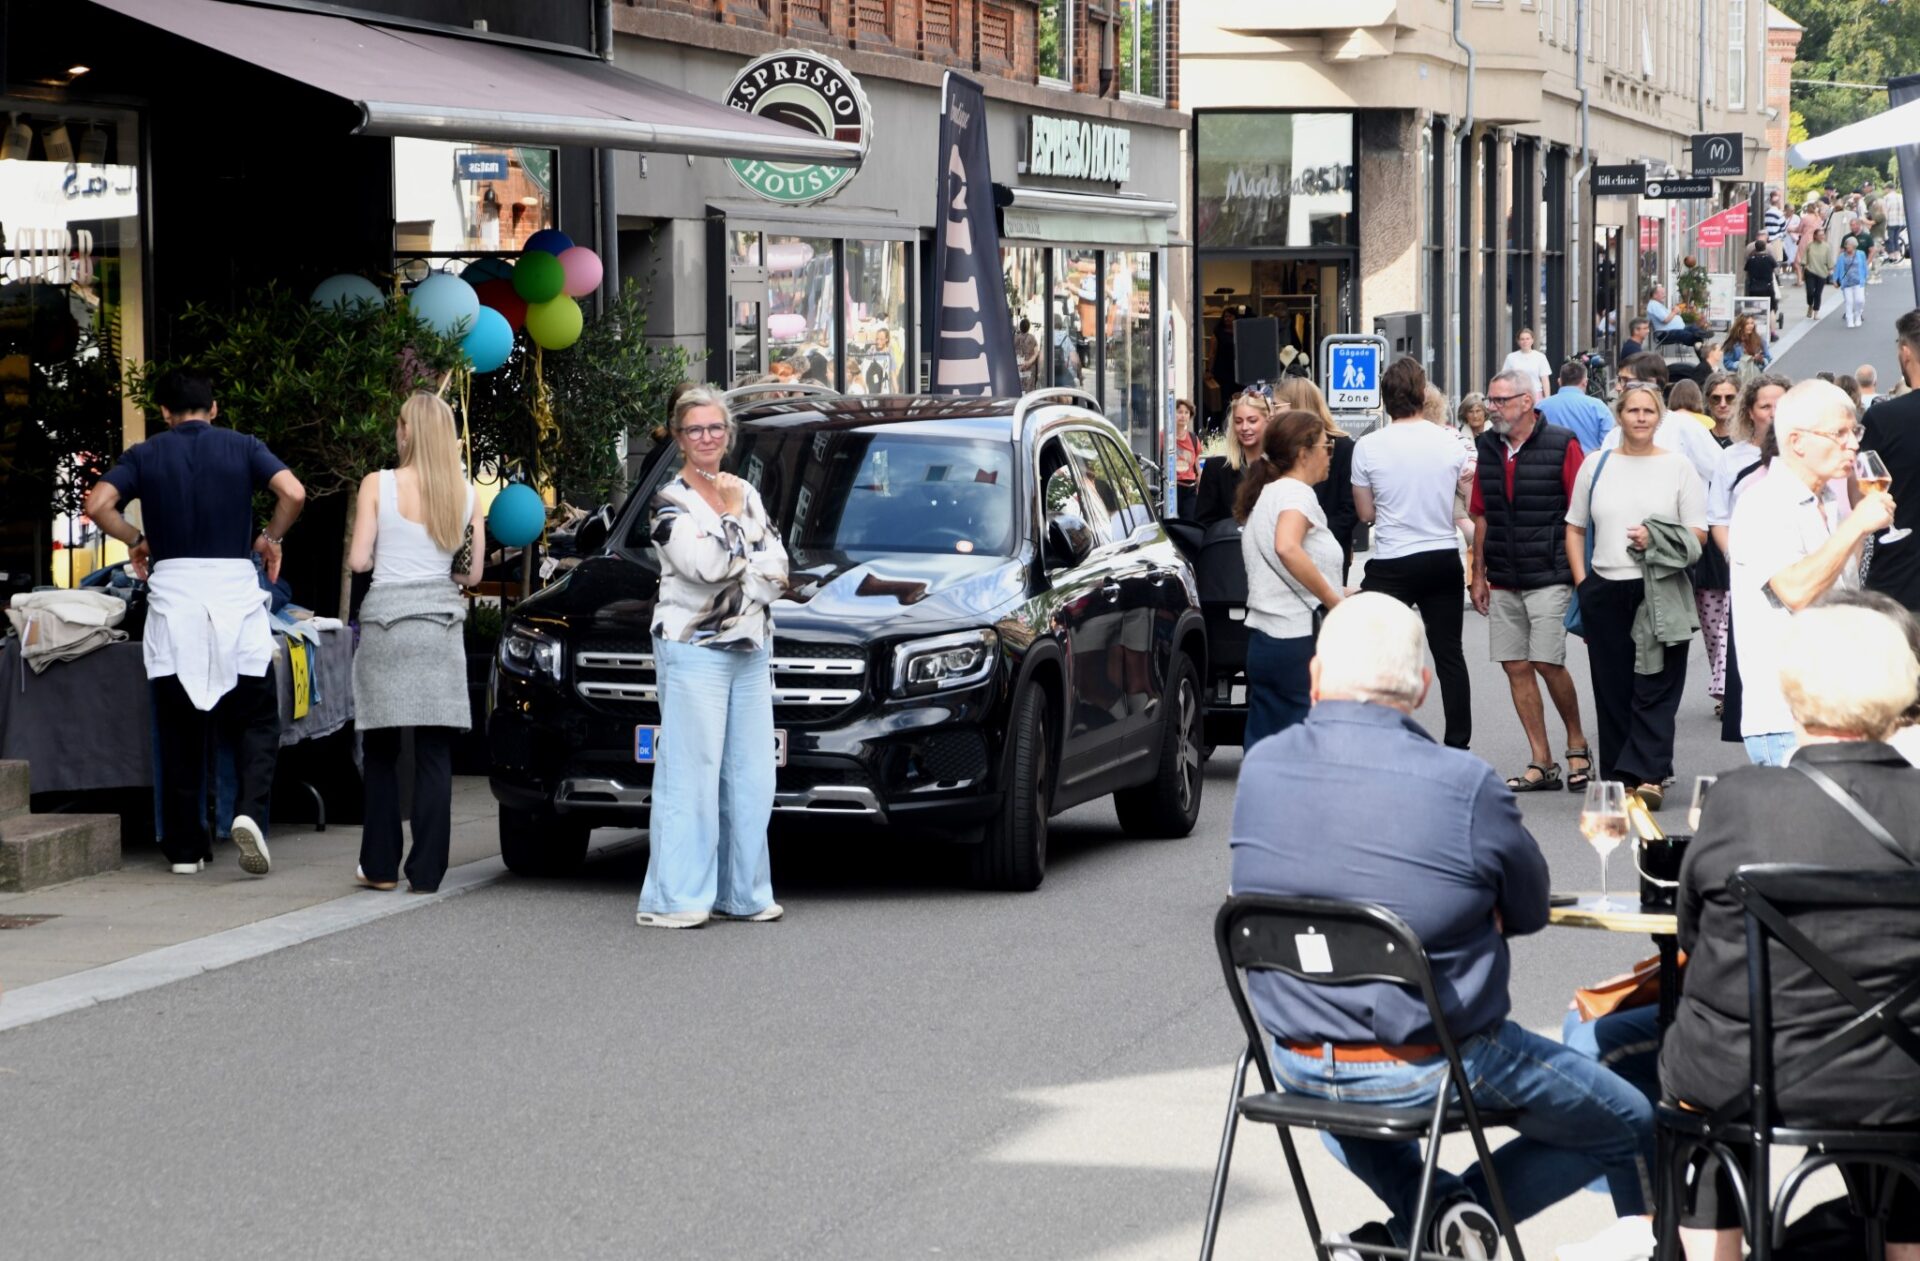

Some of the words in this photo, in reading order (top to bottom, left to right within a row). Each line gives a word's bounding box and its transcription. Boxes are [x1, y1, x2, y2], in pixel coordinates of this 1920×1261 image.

[731, 60, 854, 116] ESPRESSO
[1031, 114, 1091, 179] ESPRESSO
[1090, 124, 1131, 182] HOUSE
[743, 161, 840, 195] HOUSE
[1611, 173, 1639, 186] clinic
[1663, 185, 1711, 193] Guldsmedien
[1339, 348, 1370, 357] Gågade
[1339, 393, 1369, 402] Zone
[639, 747, 650, 755] DK
